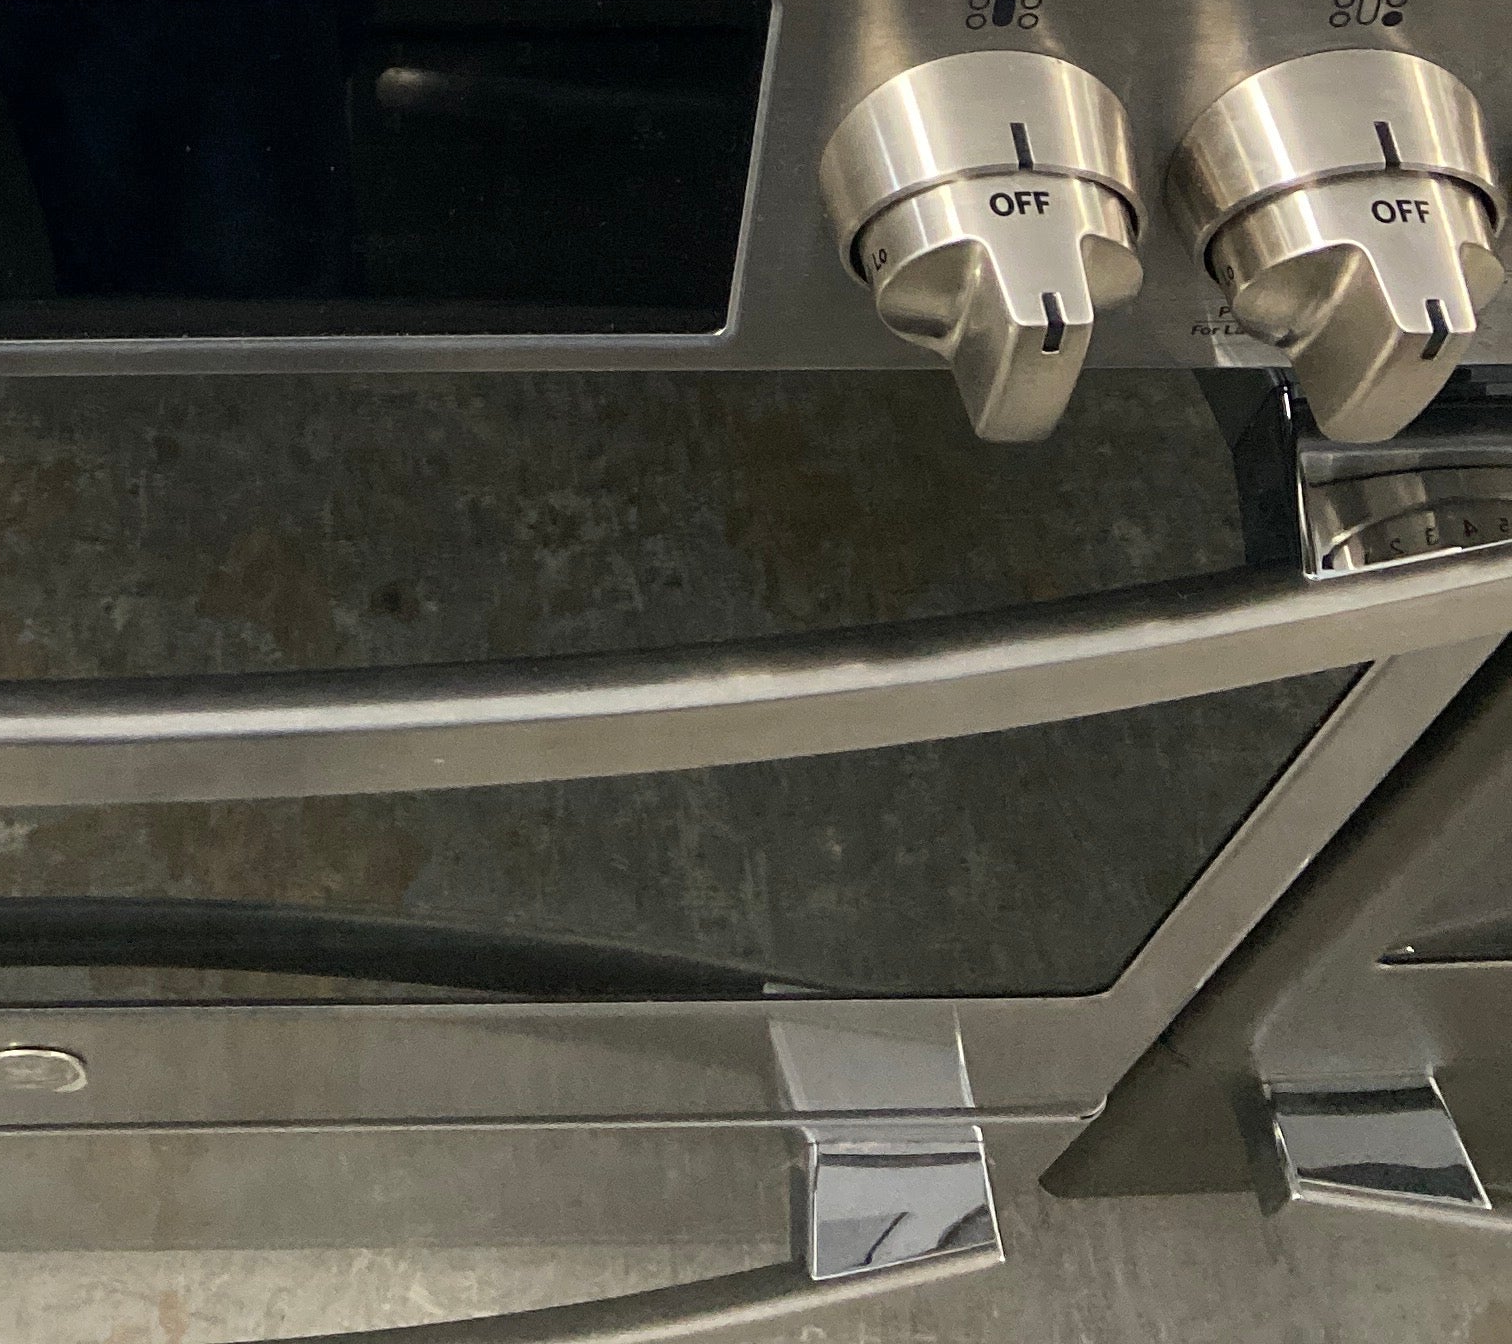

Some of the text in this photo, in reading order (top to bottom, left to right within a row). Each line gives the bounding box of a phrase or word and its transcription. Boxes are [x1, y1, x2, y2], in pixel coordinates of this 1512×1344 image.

[989, 191, 1051, 216] OFF
[1371, 199, 1431, 225] OFF
[872, 248, 887, 271] LO
[1191, 324, 1219, 335] For
